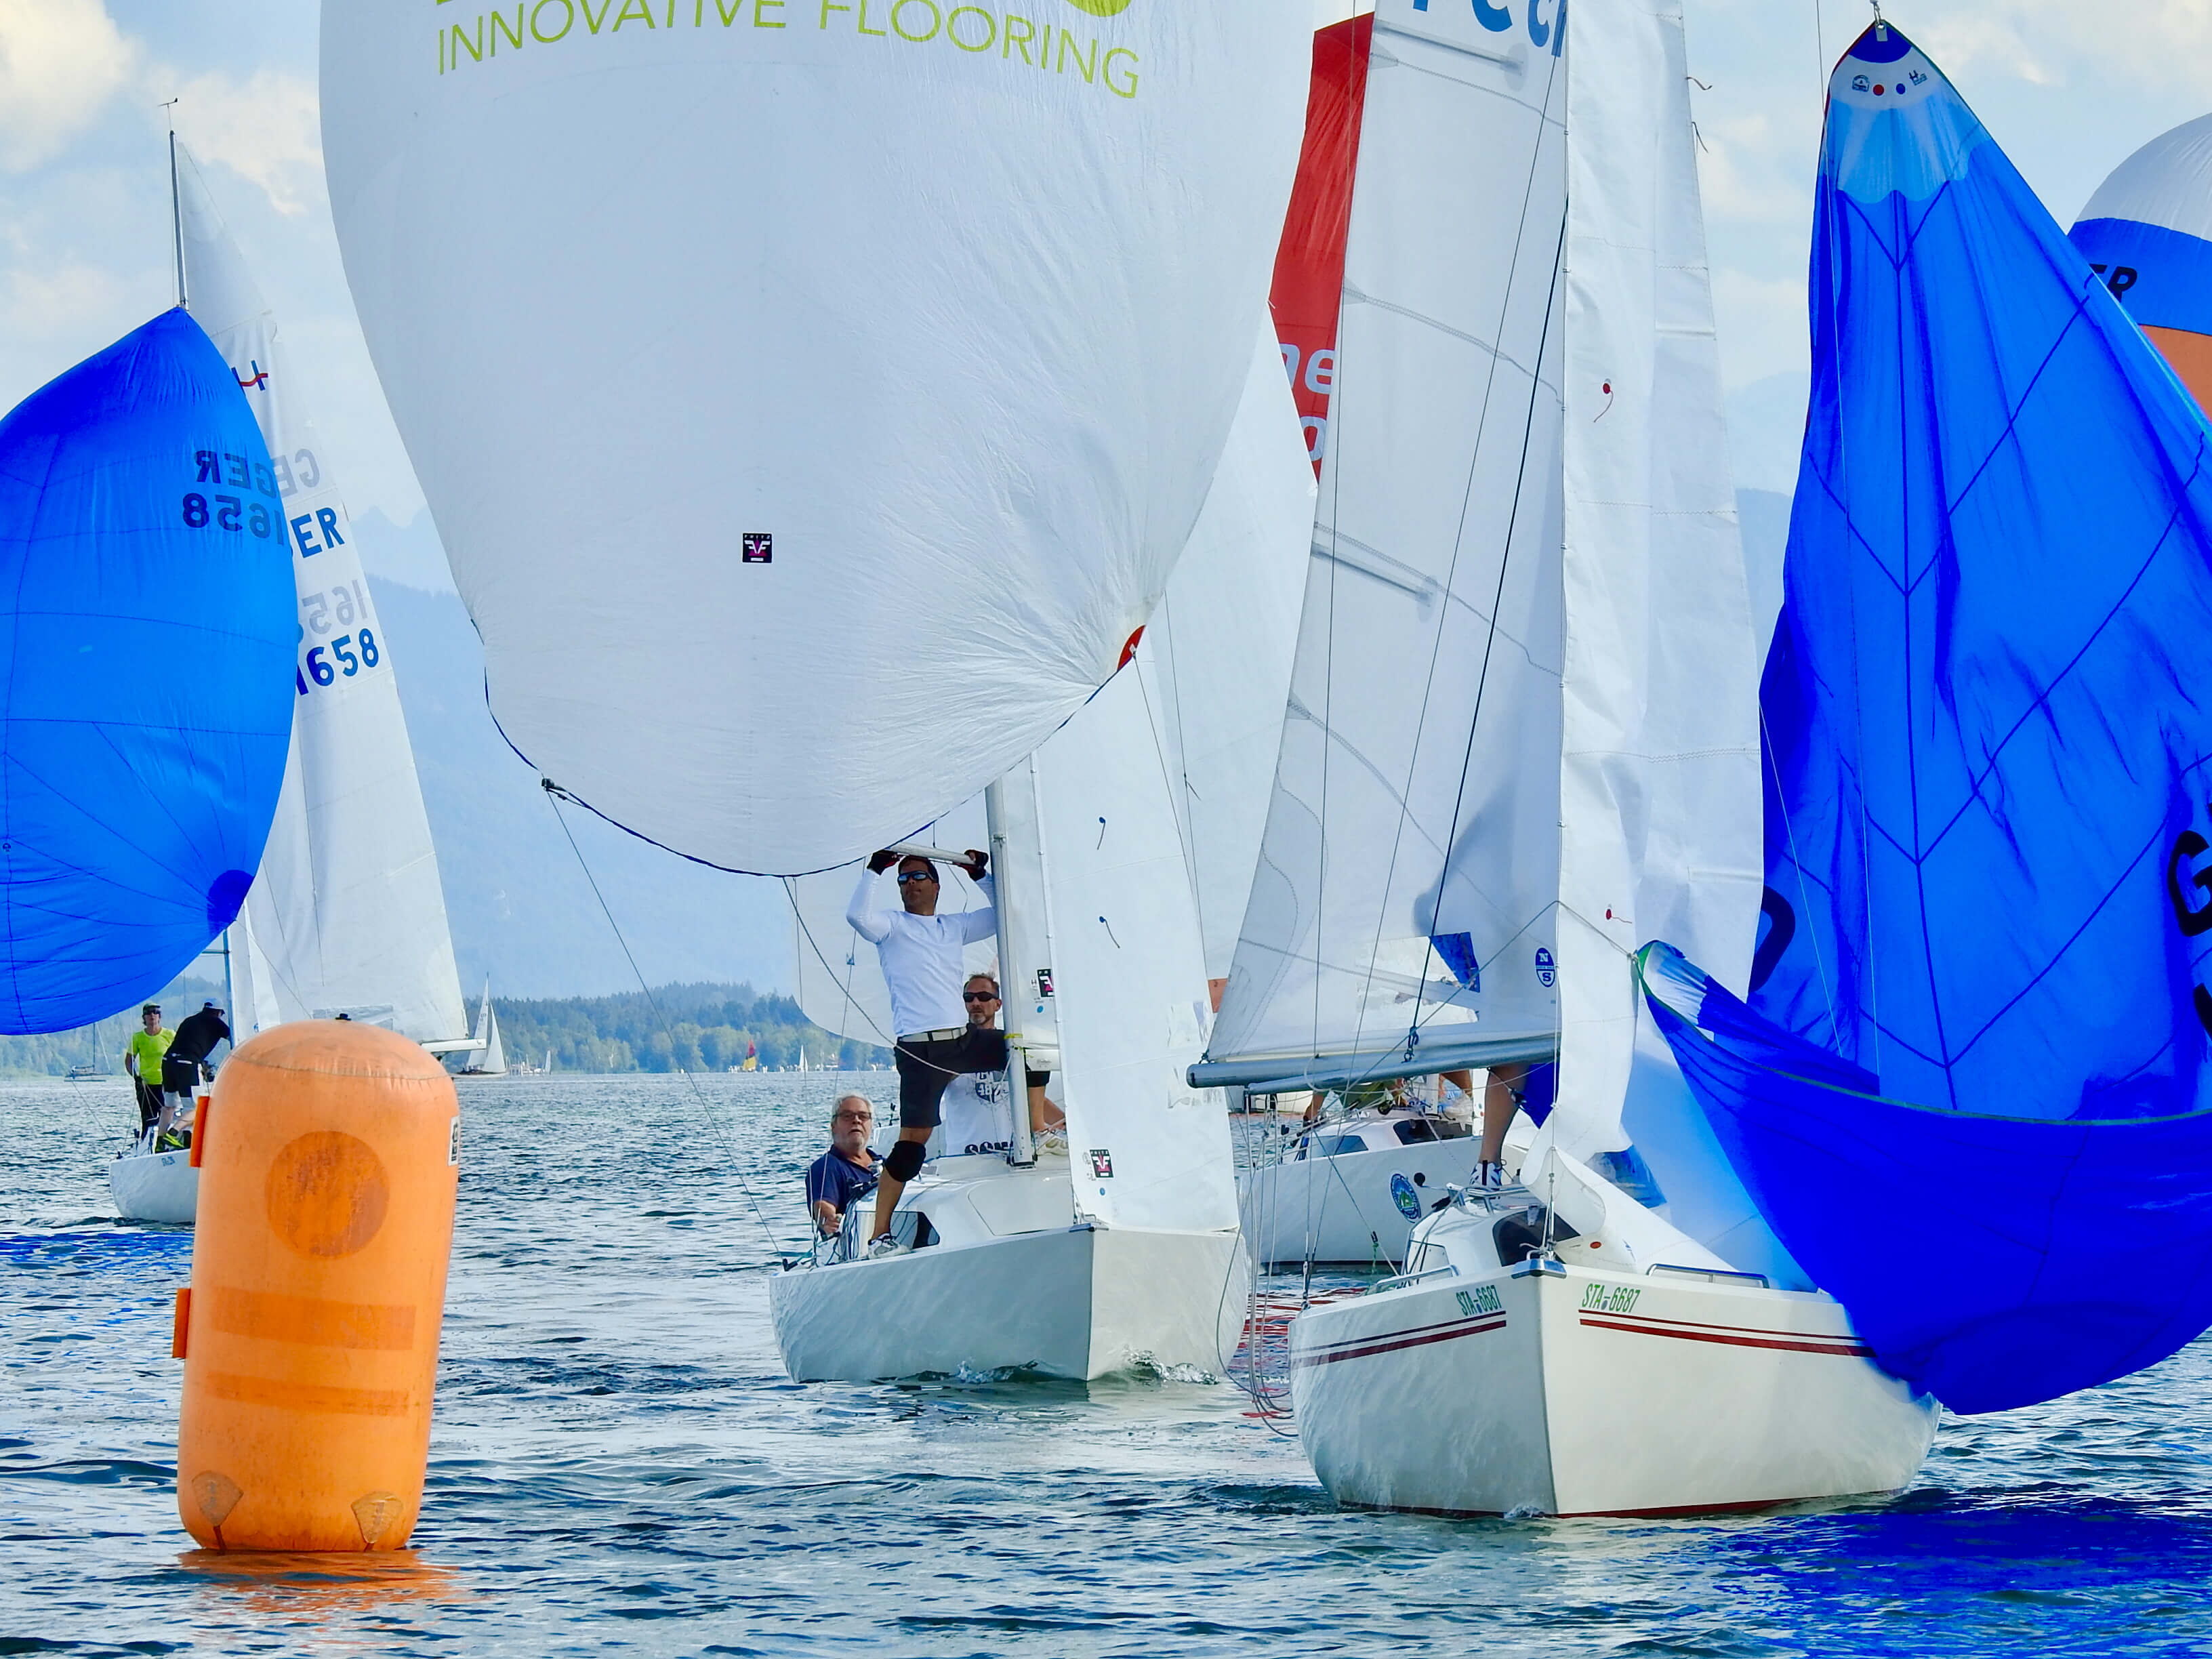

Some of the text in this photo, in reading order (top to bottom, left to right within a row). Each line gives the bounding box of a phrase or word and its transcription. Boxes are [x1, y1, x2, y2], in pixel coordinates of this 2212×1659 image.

[819, 0, 1139, 99] FLOORING
[2089, 263, 2137, 303] R
[289, 507, 345, 558] ER
[1456, 1284, 1503, 1317] STA-6687
[1581, 1282, 1641, 1313] STA-6687
